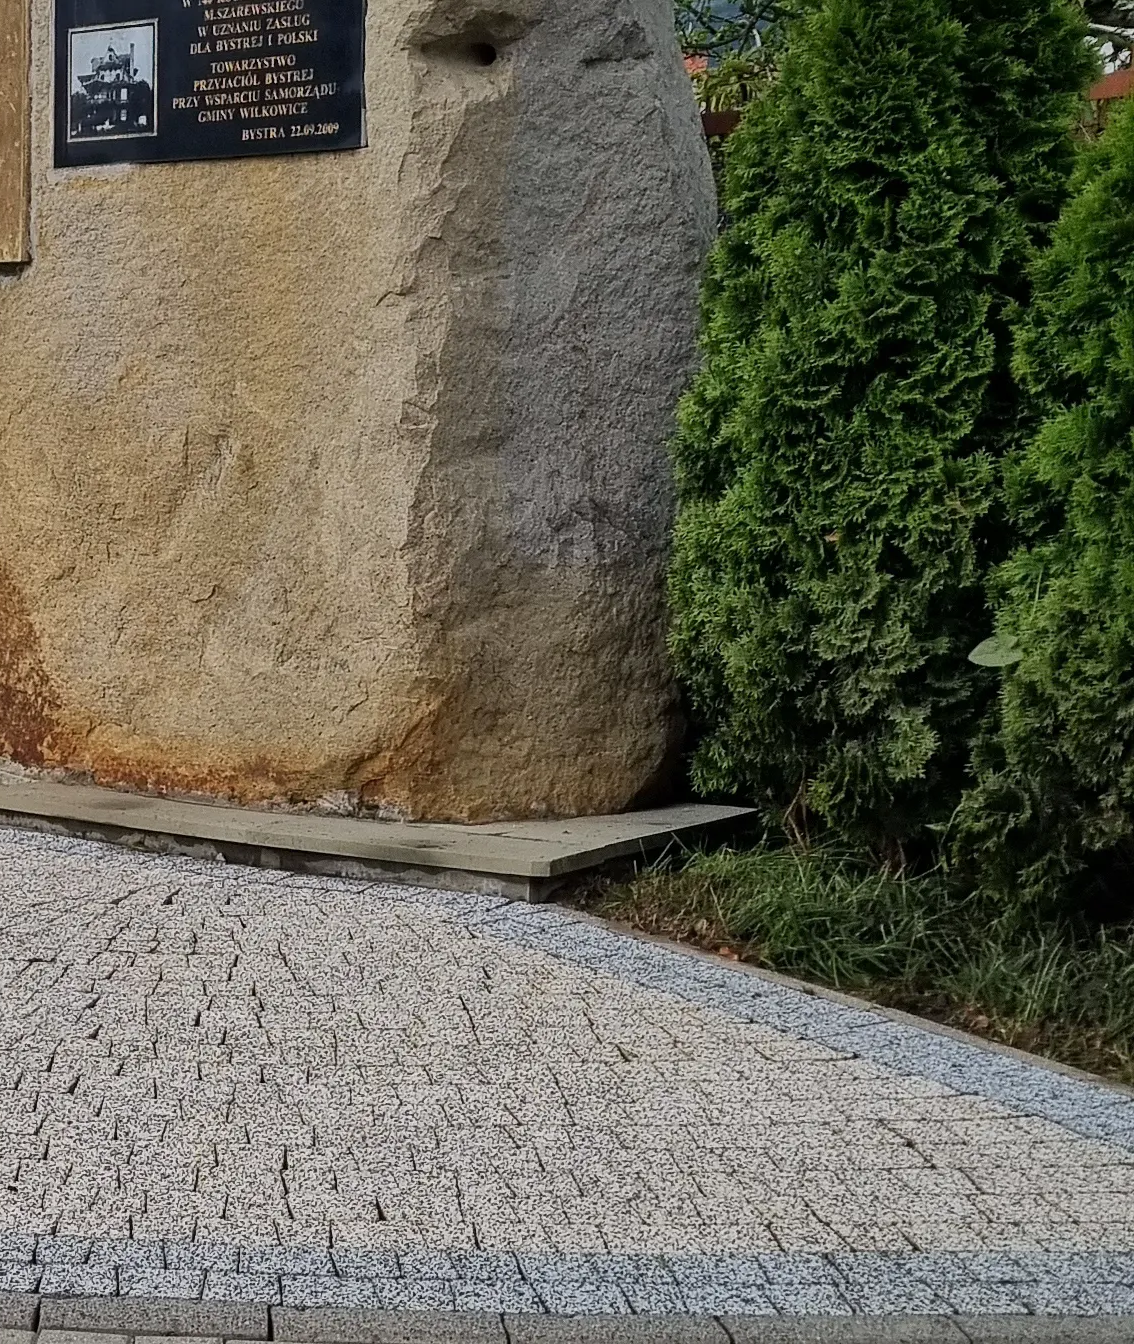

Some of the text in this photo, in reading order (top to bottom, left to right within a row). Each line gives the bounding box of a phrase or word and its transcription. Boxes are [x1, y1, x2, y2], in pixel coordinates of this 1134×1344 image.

[197, 25, 209, 38] W
[212, 18, 262, 36] UZNANIU
[189, 29, 319, 55] DLA BYSTREJ I POLSKI
[210, 54, 296, 74] TOWARZYSTWO
[265, 68, 314, 85] BYSTREJ
[172, 82, 337, 110] PRZY WSPARCIU SAMORZĄDU
[197, 102, 308, 123] GMINY WILKOWICE
[242, 126, 286, 141] BYSTRA
